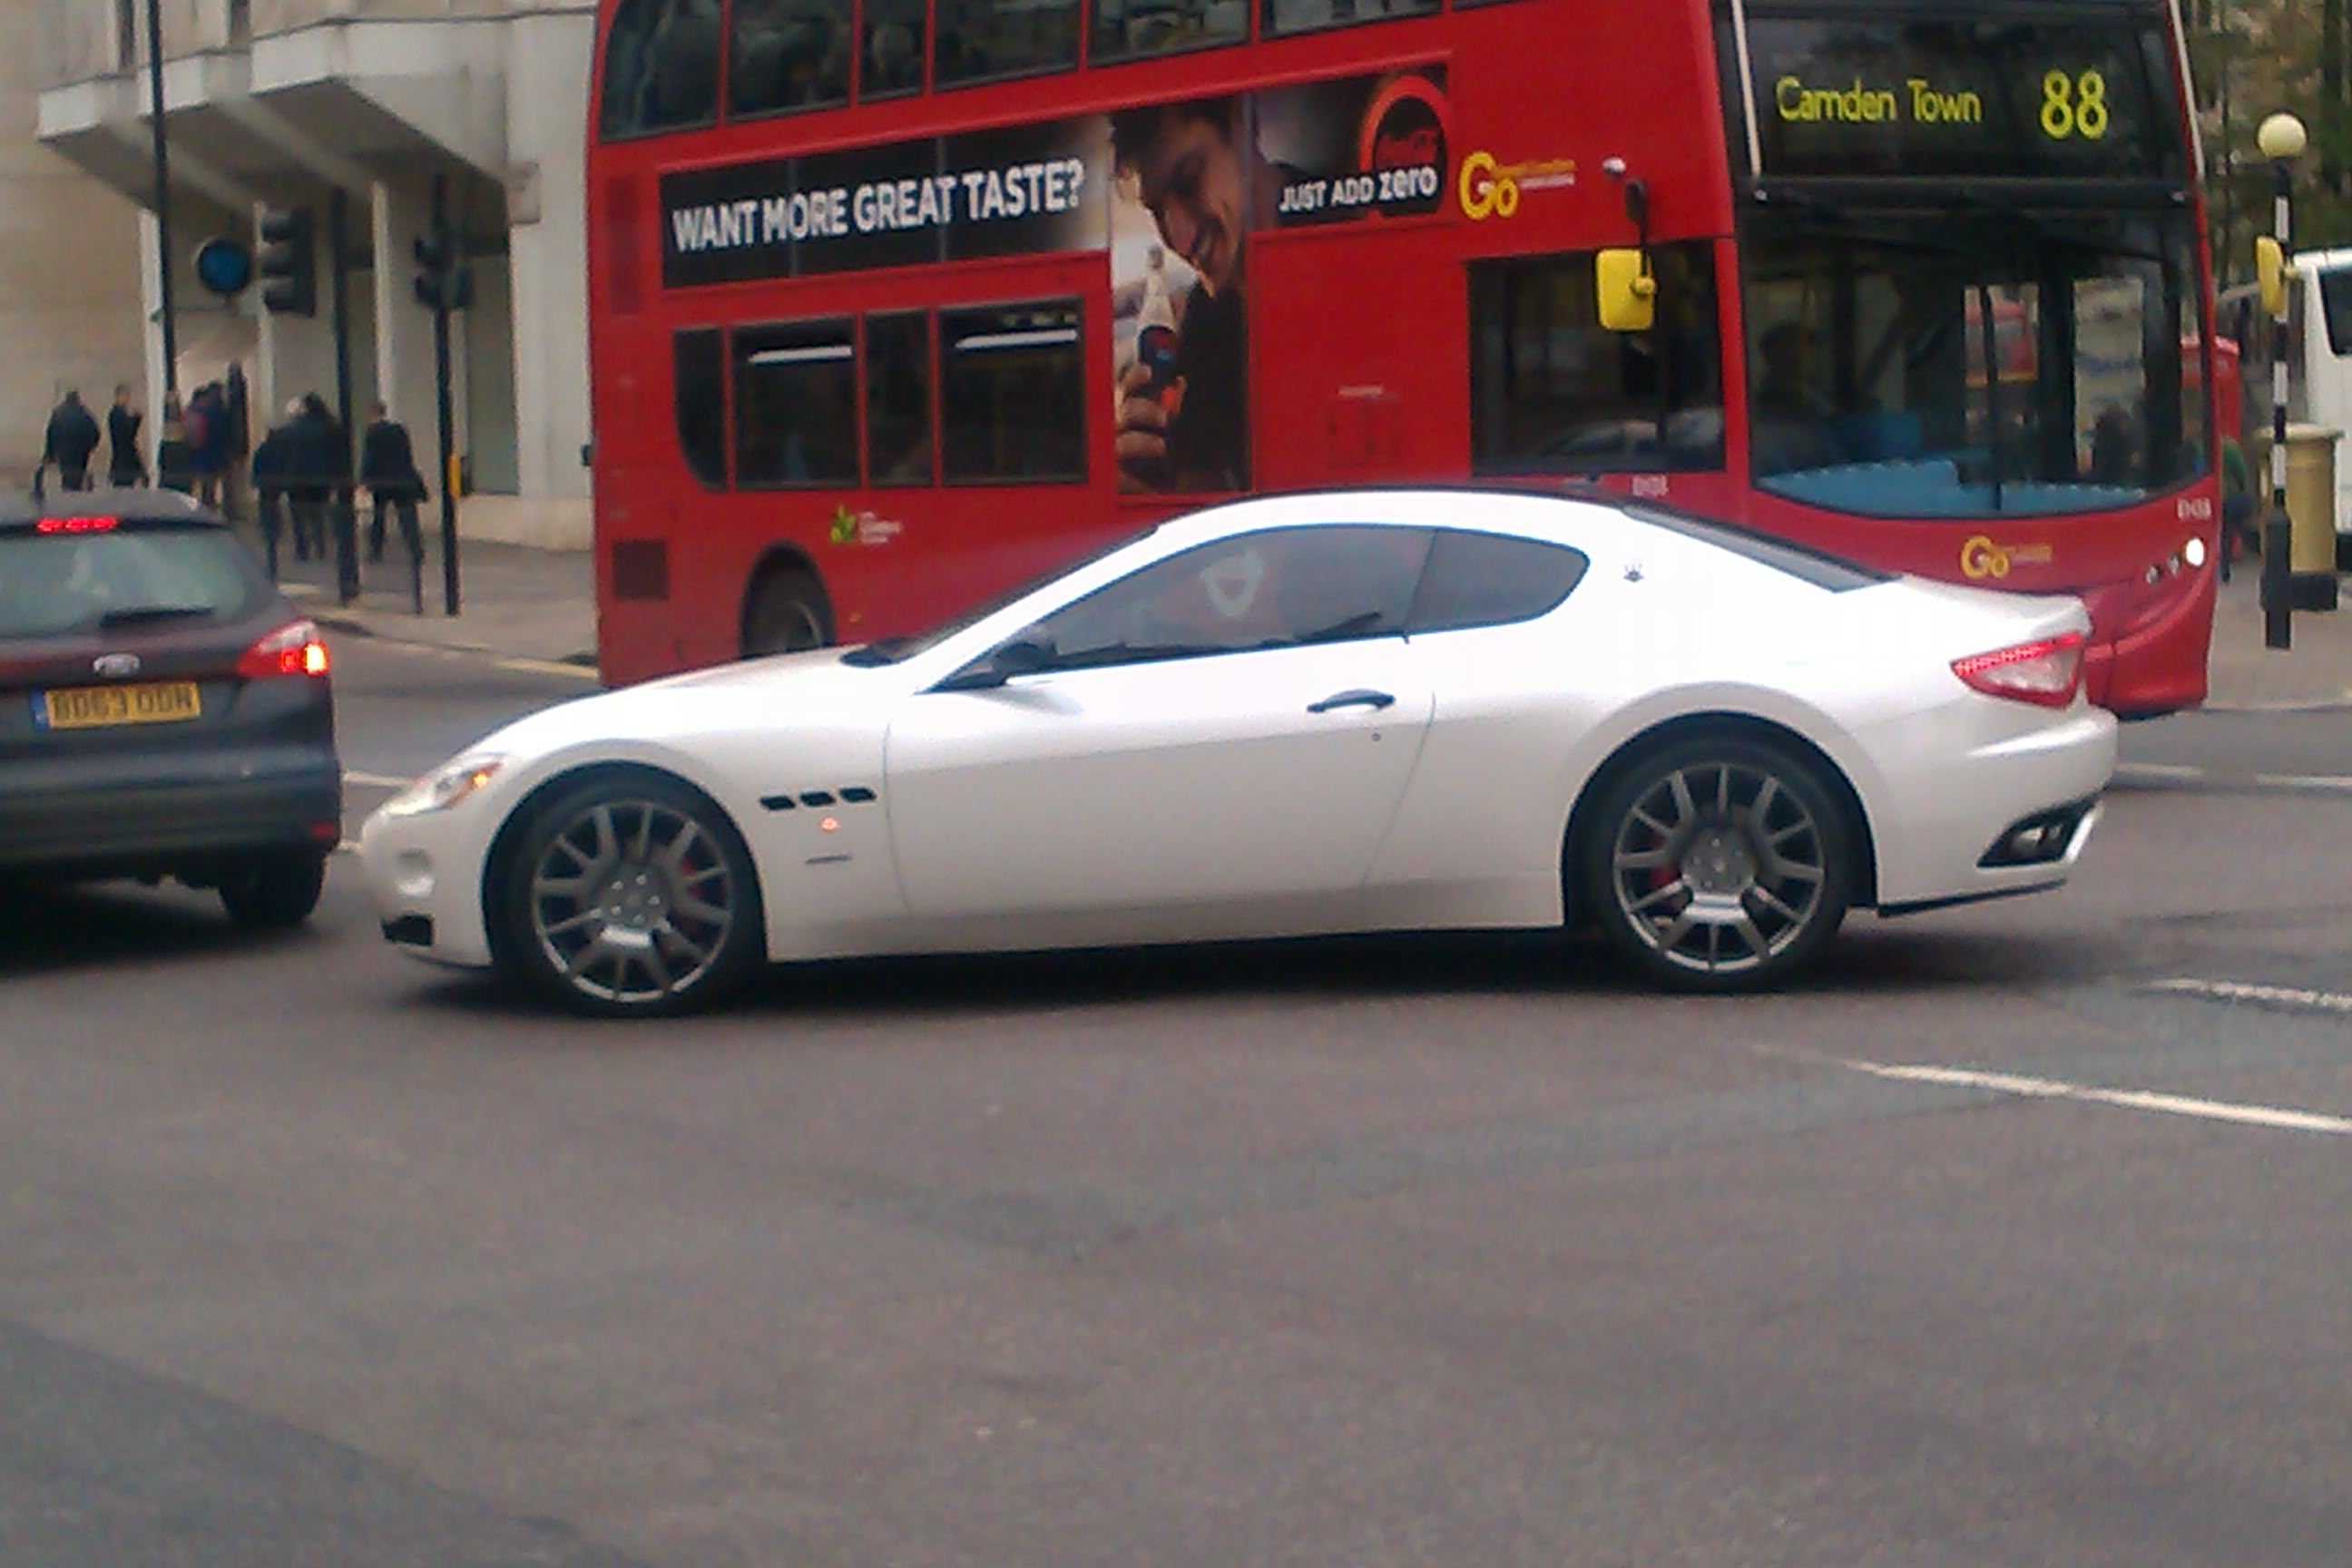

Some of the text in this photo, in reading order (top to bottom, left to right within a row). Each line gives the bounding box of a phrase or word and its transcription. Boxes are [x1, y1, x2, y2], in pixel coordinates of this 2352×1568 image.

[1776, 68, 2109, 140] Camden Town 88
[672, 157, 1085, 253] WANT MORE GREAT TASTE?
[1279, 165, 1438, 212] JUST ADD zero
[1458, 150, 1519, 221] Go
[1960, 534, 2010, 579] Go
